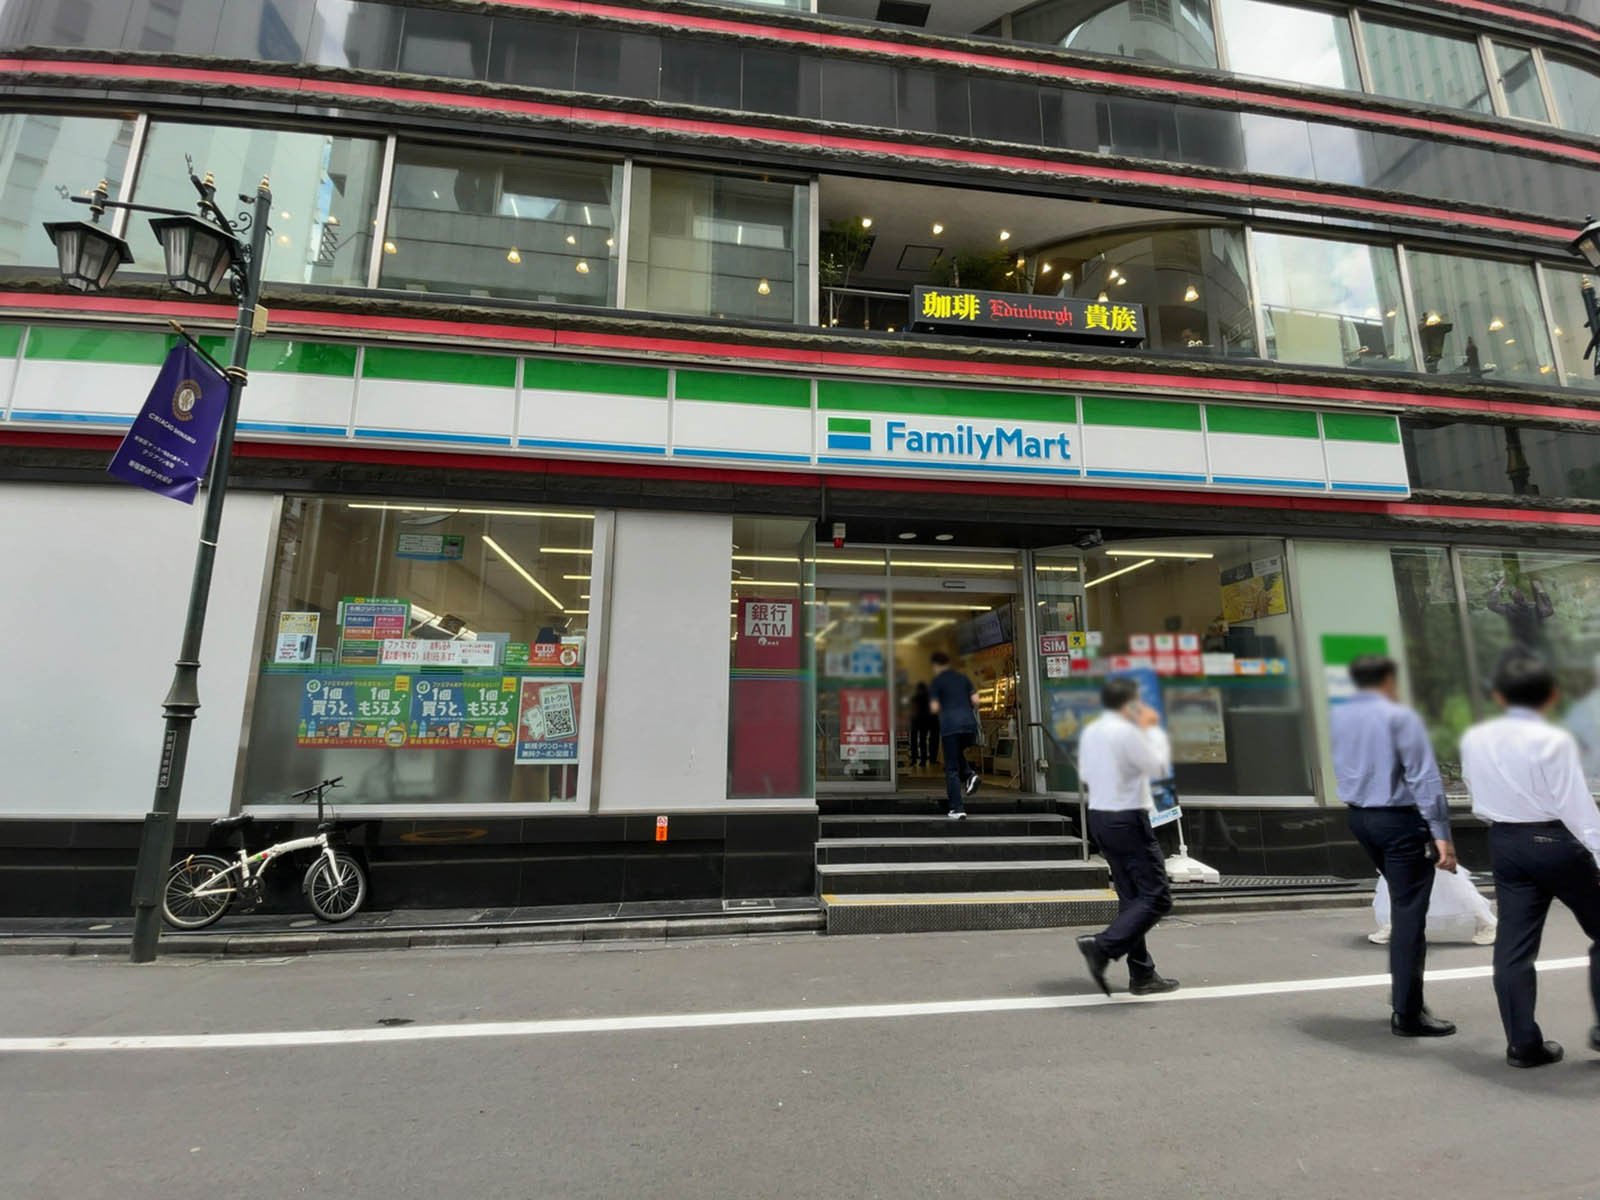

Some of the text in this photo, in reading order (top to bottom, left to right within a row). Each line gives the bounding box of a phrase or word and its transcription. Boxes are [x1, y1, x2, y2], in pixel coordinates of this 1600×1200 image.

[922, 291, 1138, 332] 珈琲 Edinburgh 貴族
[886, 421, 1071, 460] FamilyMart
[752, 604, 787, 622] 銀行
[751, 623, 786, 636] ATM
[1042, 641, 1065, 652] SIM
[322, 686, 343, 700] 1個
[371, 686, 391, 701] 1個
[432, 687, 452, 701] 1個
[479, 687, 498, 701] 1個
[358, 700, 401, 716] もらえる
[467, 701, 509, 717] もらえる
[847, 695, 881, 713] TAX
[846, 714, 881, 731] FREE
